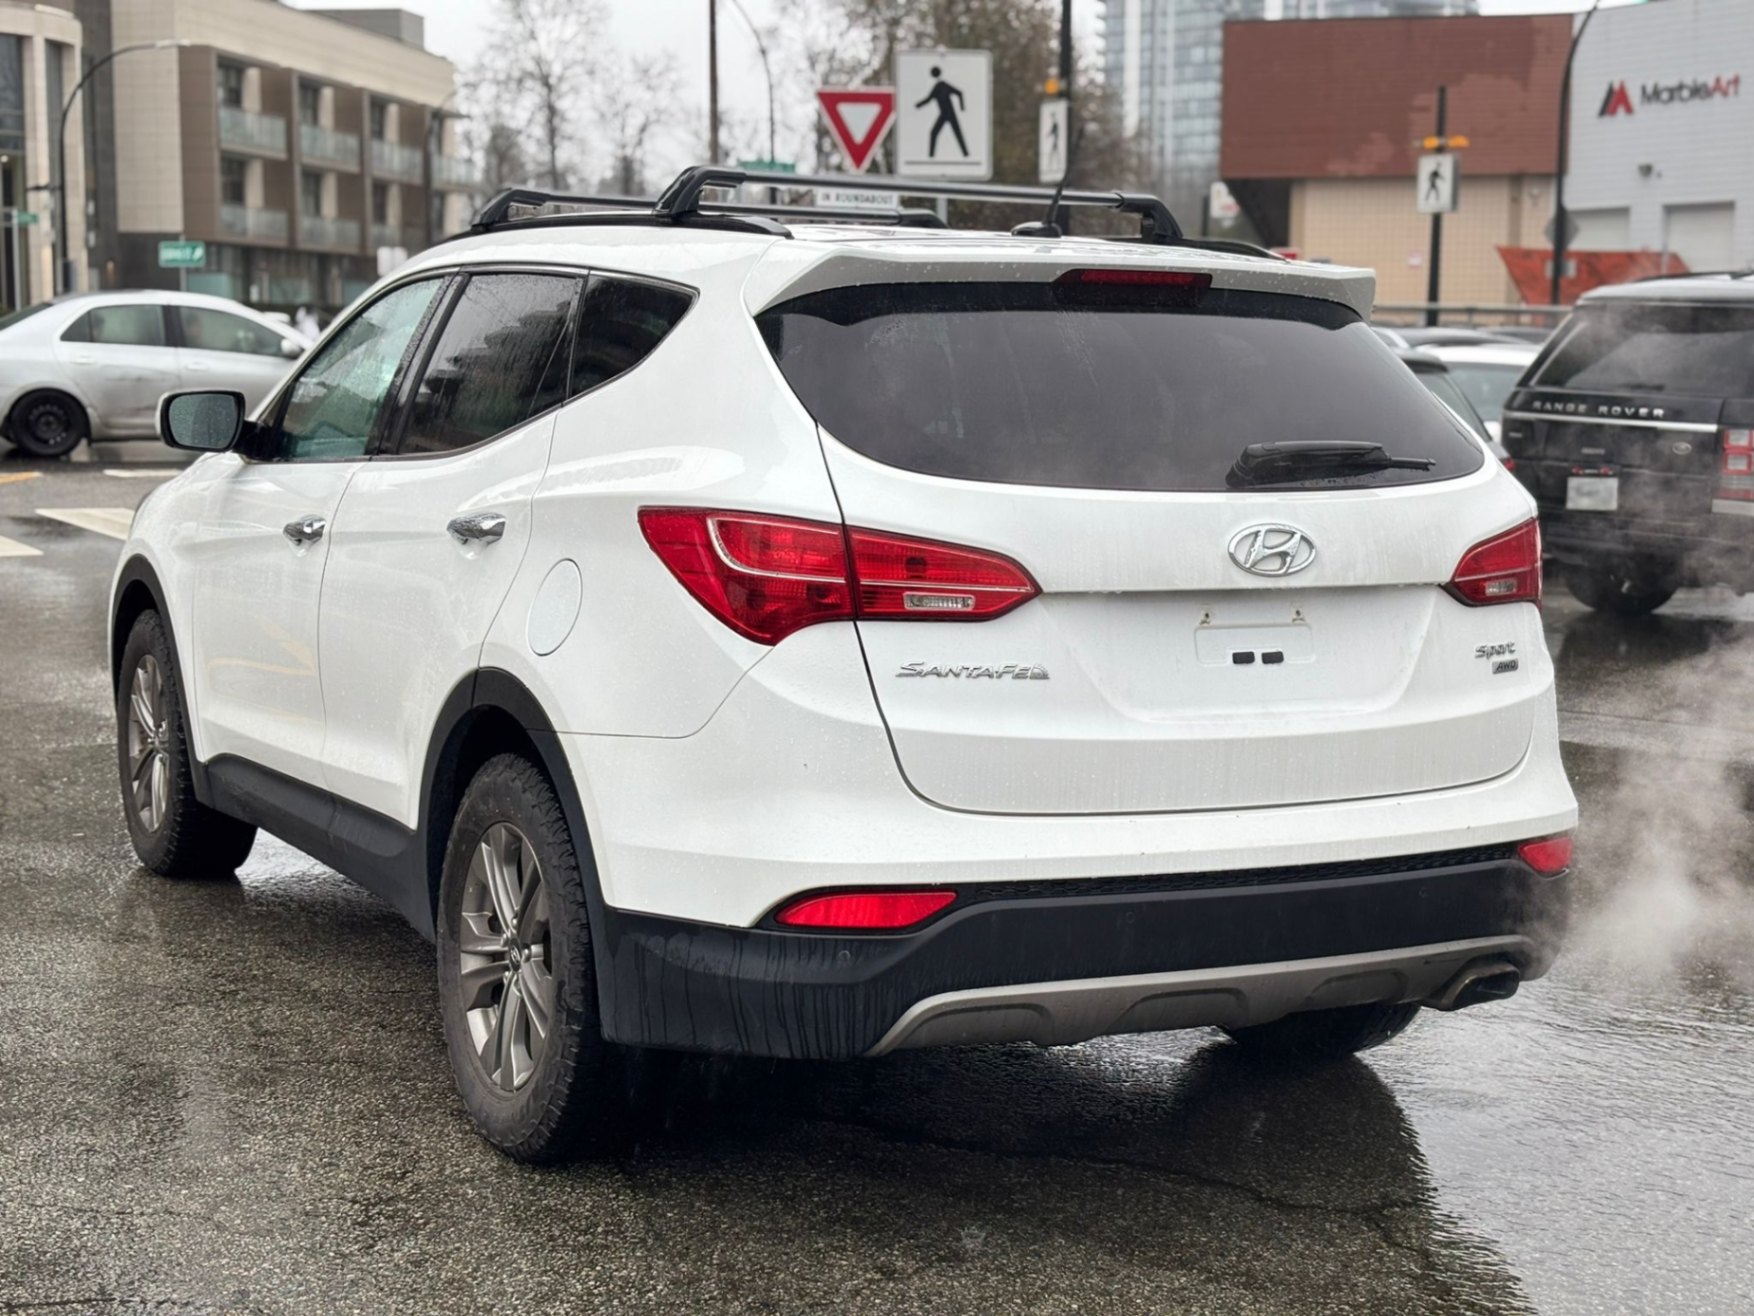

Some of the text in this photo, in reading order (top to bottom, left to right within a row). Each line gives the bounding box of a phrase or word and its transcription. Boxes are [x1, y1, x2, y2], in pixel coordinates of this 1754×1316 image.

[1532, 401, 1665, 418] RANGE ROVER
[1496, 659, 1517, 672] AWD
